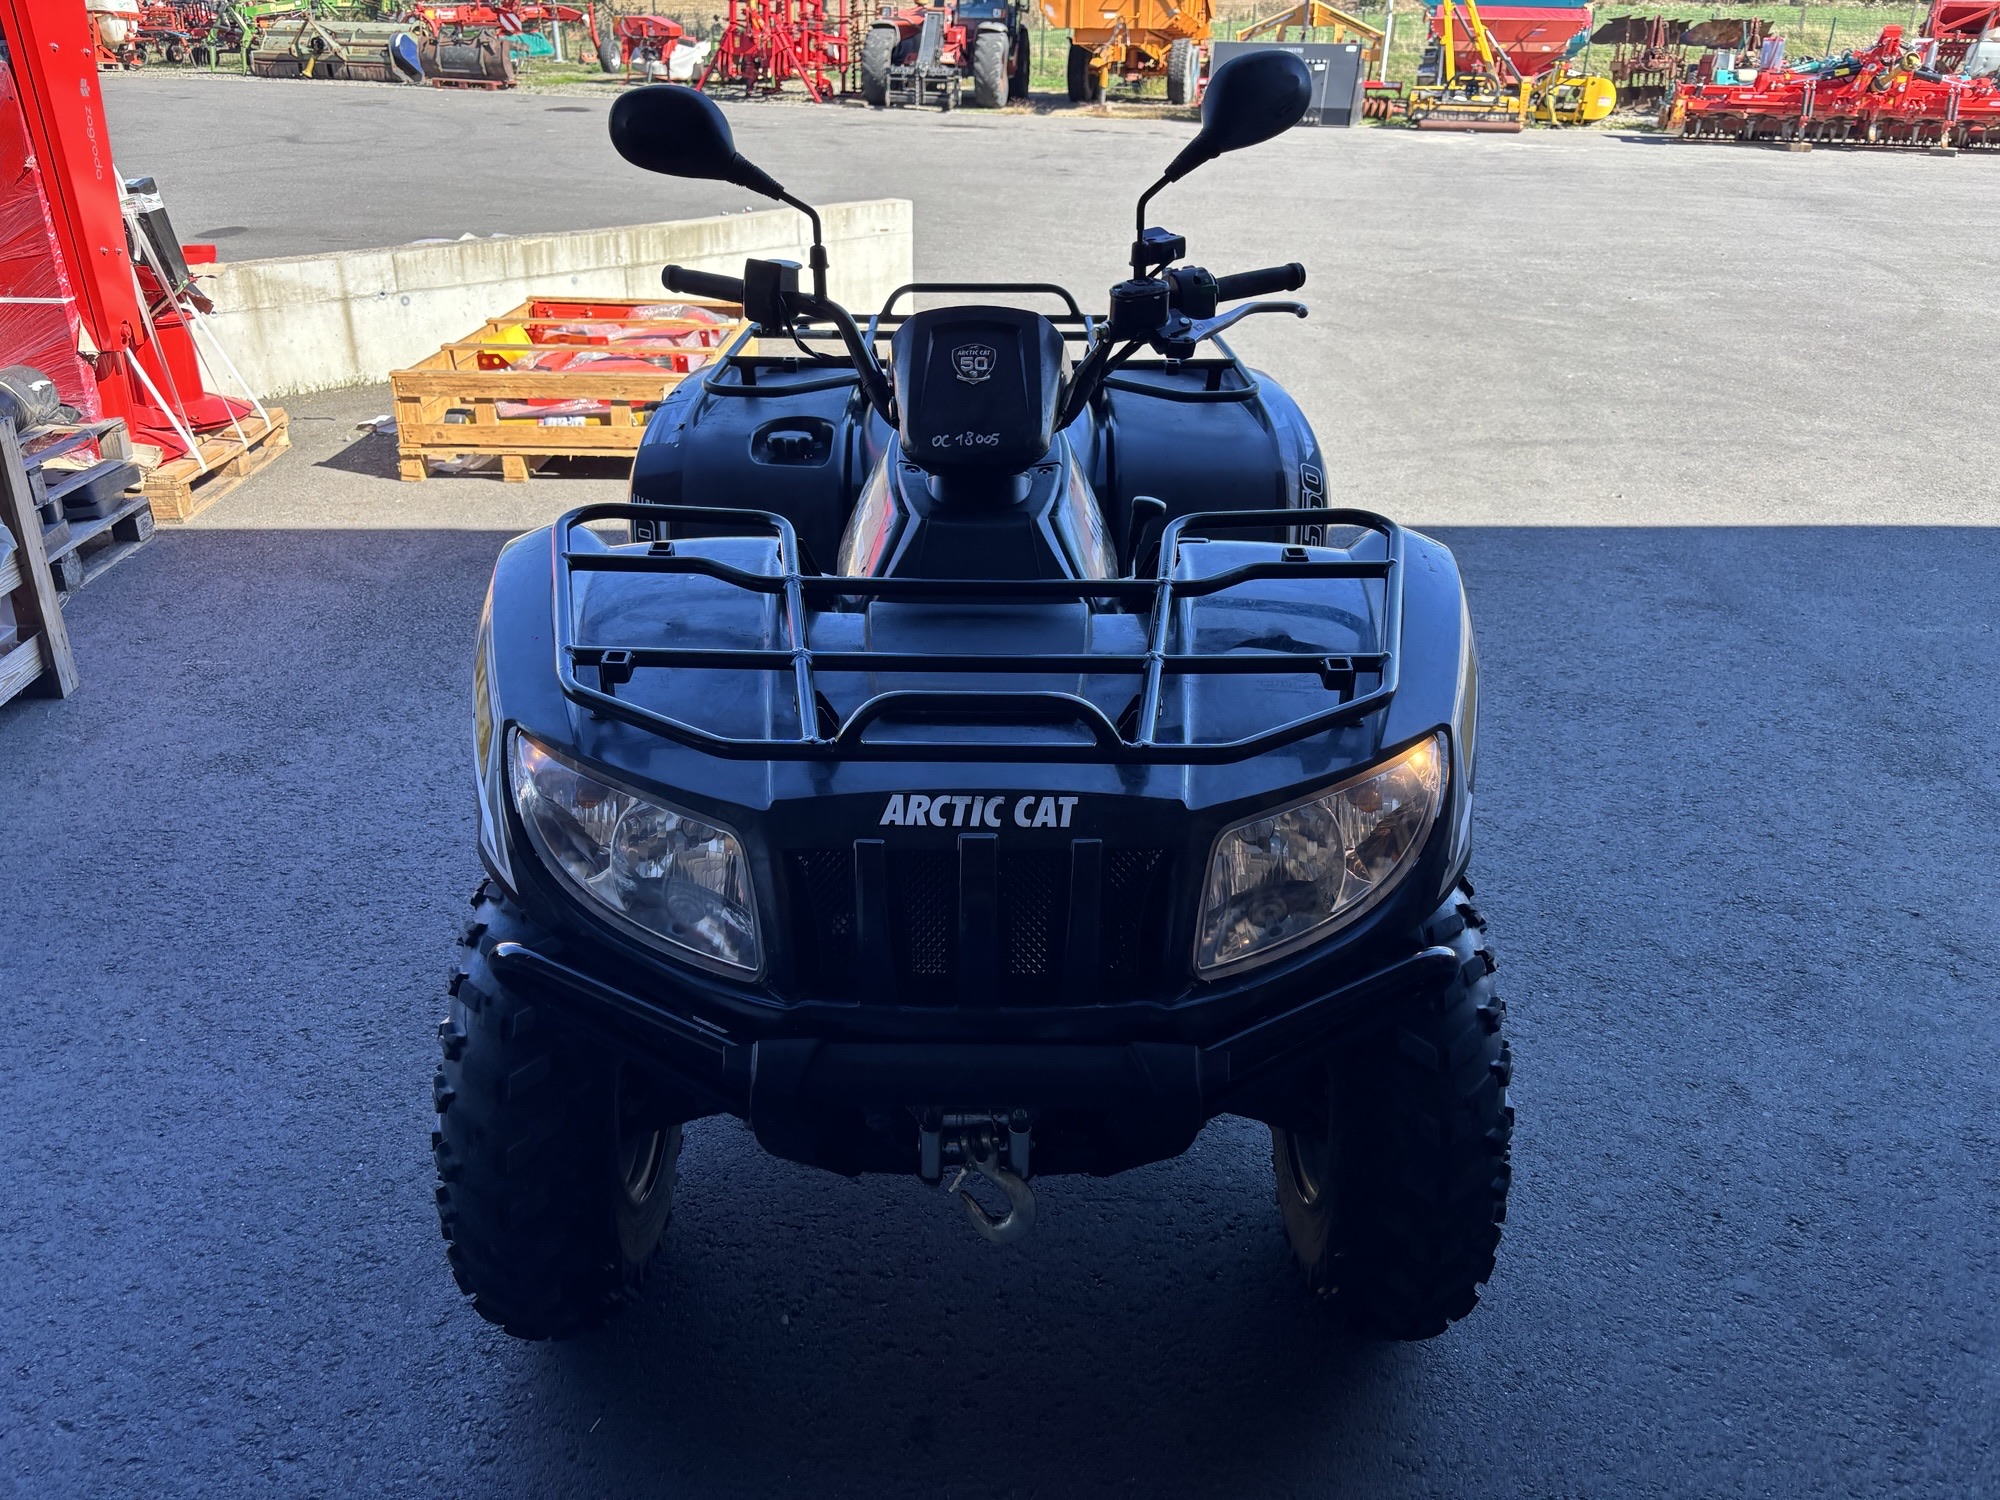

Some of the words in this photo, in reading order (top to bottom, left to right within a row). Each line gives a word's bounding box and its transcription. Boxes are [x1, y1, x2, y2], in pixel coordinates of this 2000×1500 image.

[960, 356, 988, 371] 50
[879, 794, 1006, 827] ARCTIC
[1013, 795, 1079, 828] CAT
